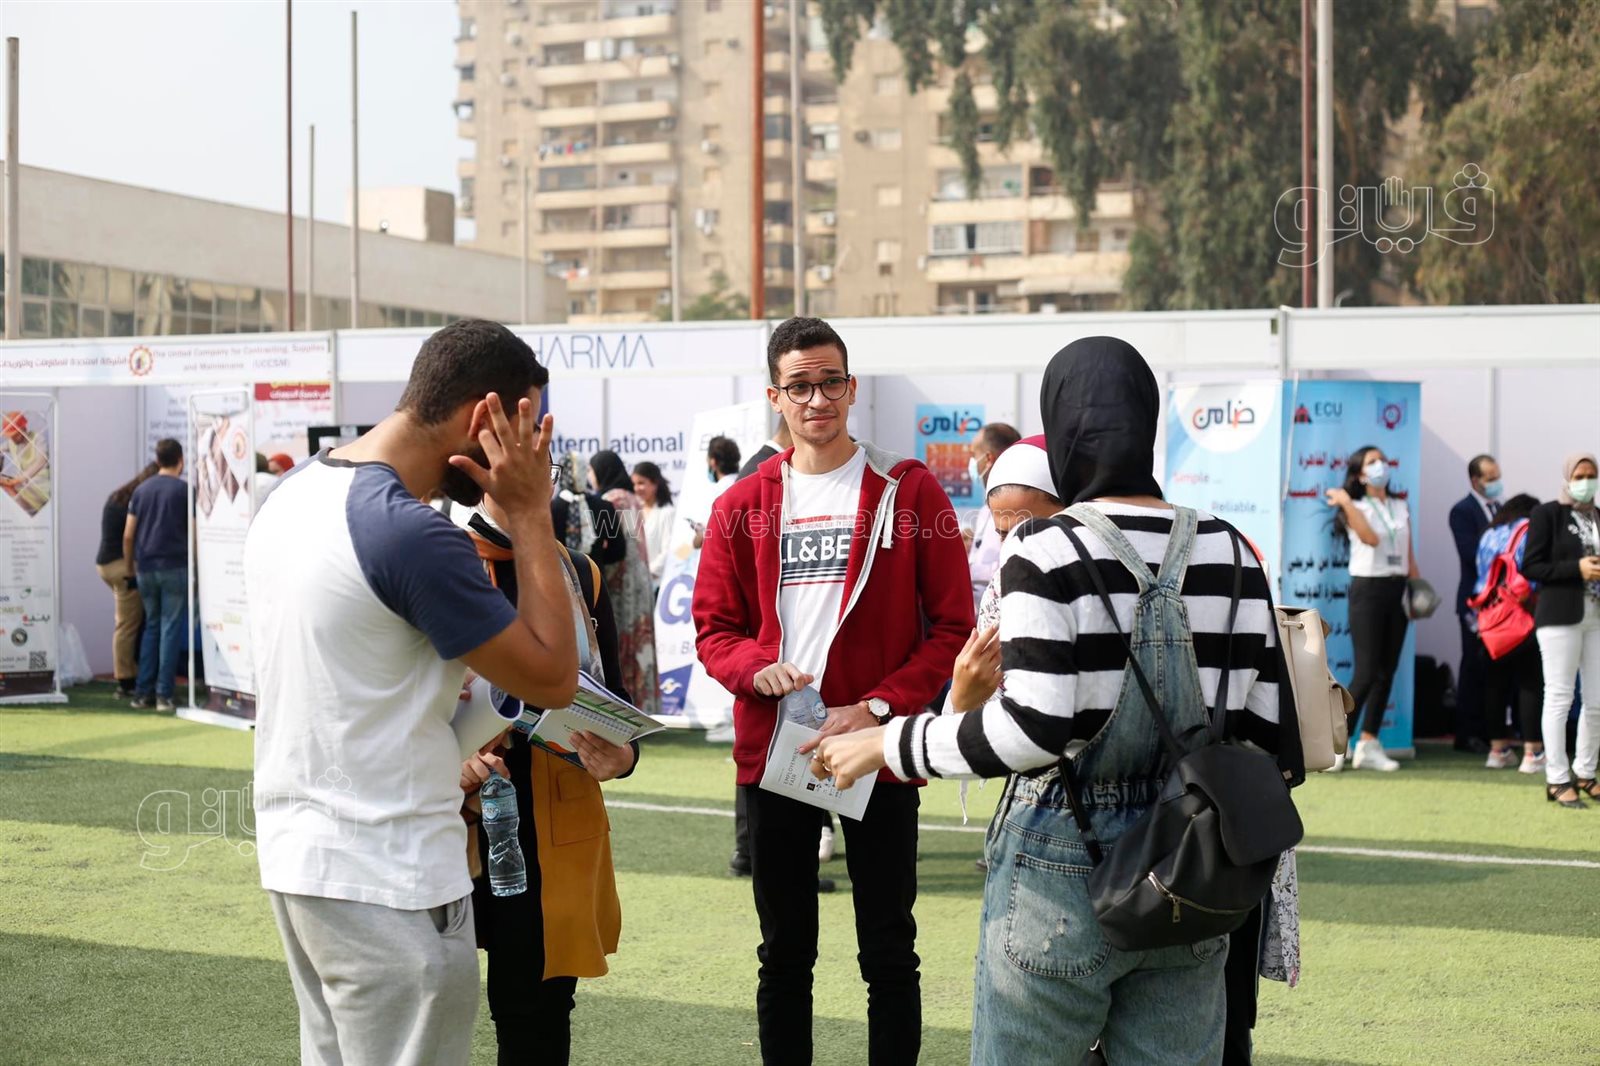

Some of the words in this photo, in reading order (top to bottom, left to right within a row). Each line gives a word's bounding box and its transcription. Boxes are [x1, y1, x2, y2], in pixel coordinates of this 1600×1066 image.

[168, 349, 192, 358] United
[194, 347, 229, 358] Company
[1192, 399, 1255, 431] ضامن
[1314, 402, 1343, 418] ECU
[918, 410, 982, 436] ضامن
[1211, 499, 1257, 513] Reliable
[782, 533, 851, 563] L&BE
